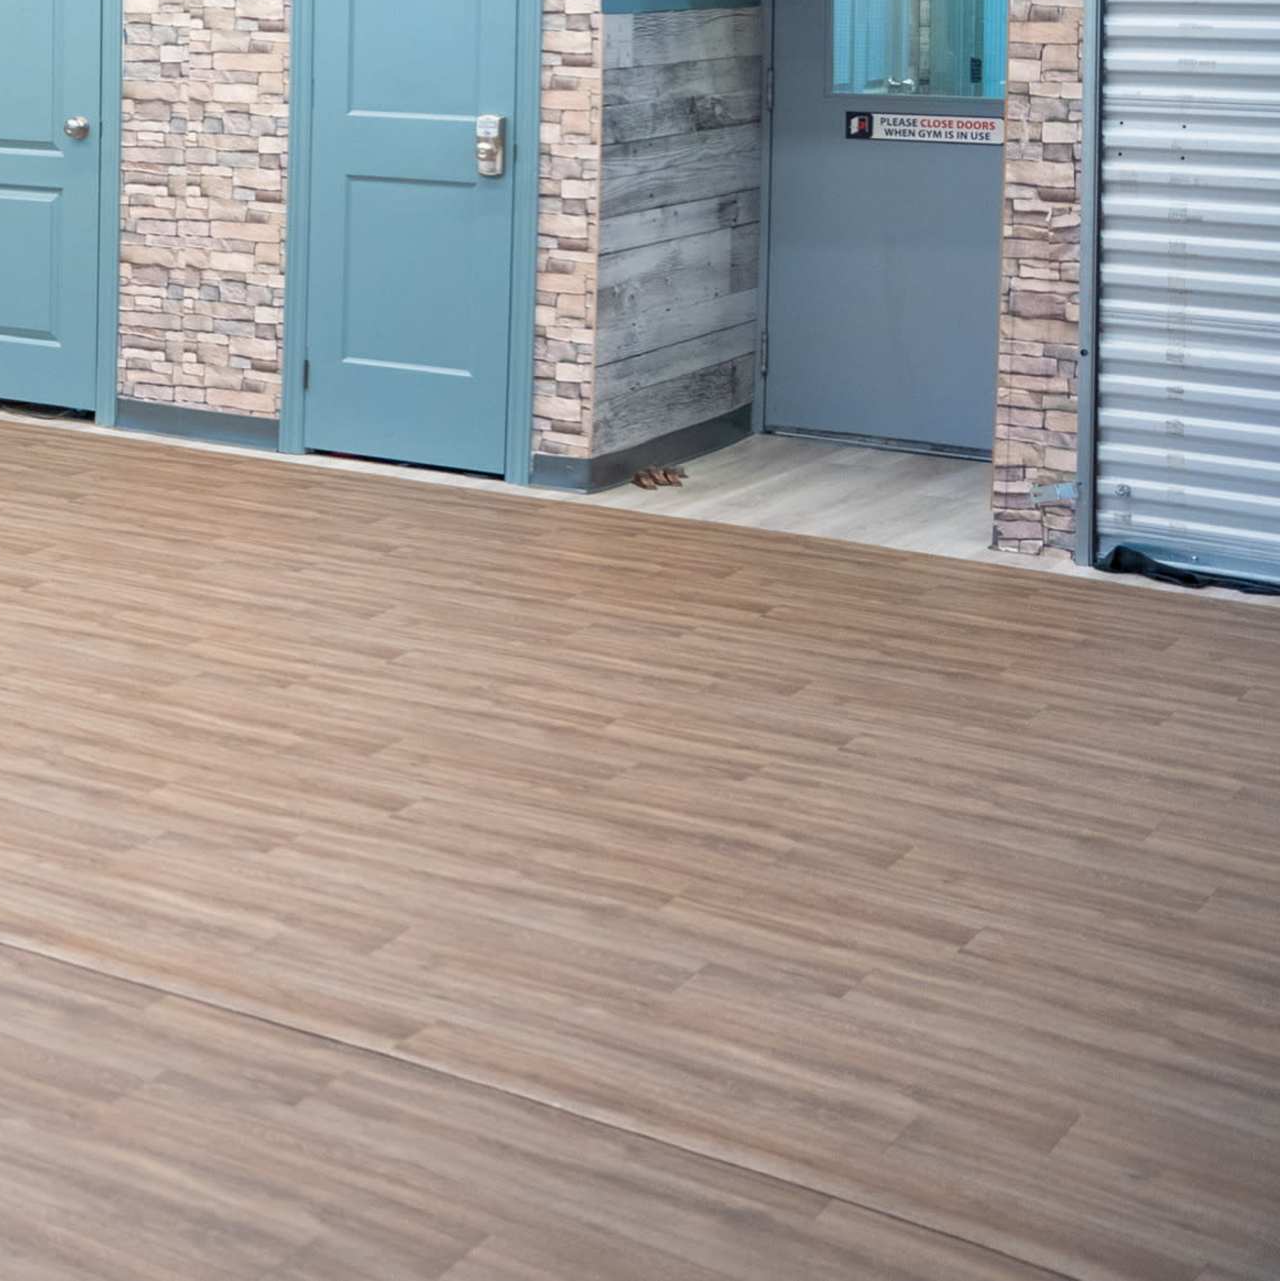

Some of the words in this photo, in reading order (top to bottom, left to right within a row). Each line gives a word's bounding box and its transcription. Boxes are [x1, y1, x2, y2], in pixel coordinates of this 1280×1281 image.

[880, 117, 918, 129] PLEASE
[920, 119, 954, 129] CLOSE
[957, 120, 996, 130] DOORS
[884, 128, 916, 138] WHEN
[918, 129, 943, 138] GYM
[945, 129, 955, 139] IS
[957, 130, 968, 140] IN
[970, 131, 991, 141] USE
